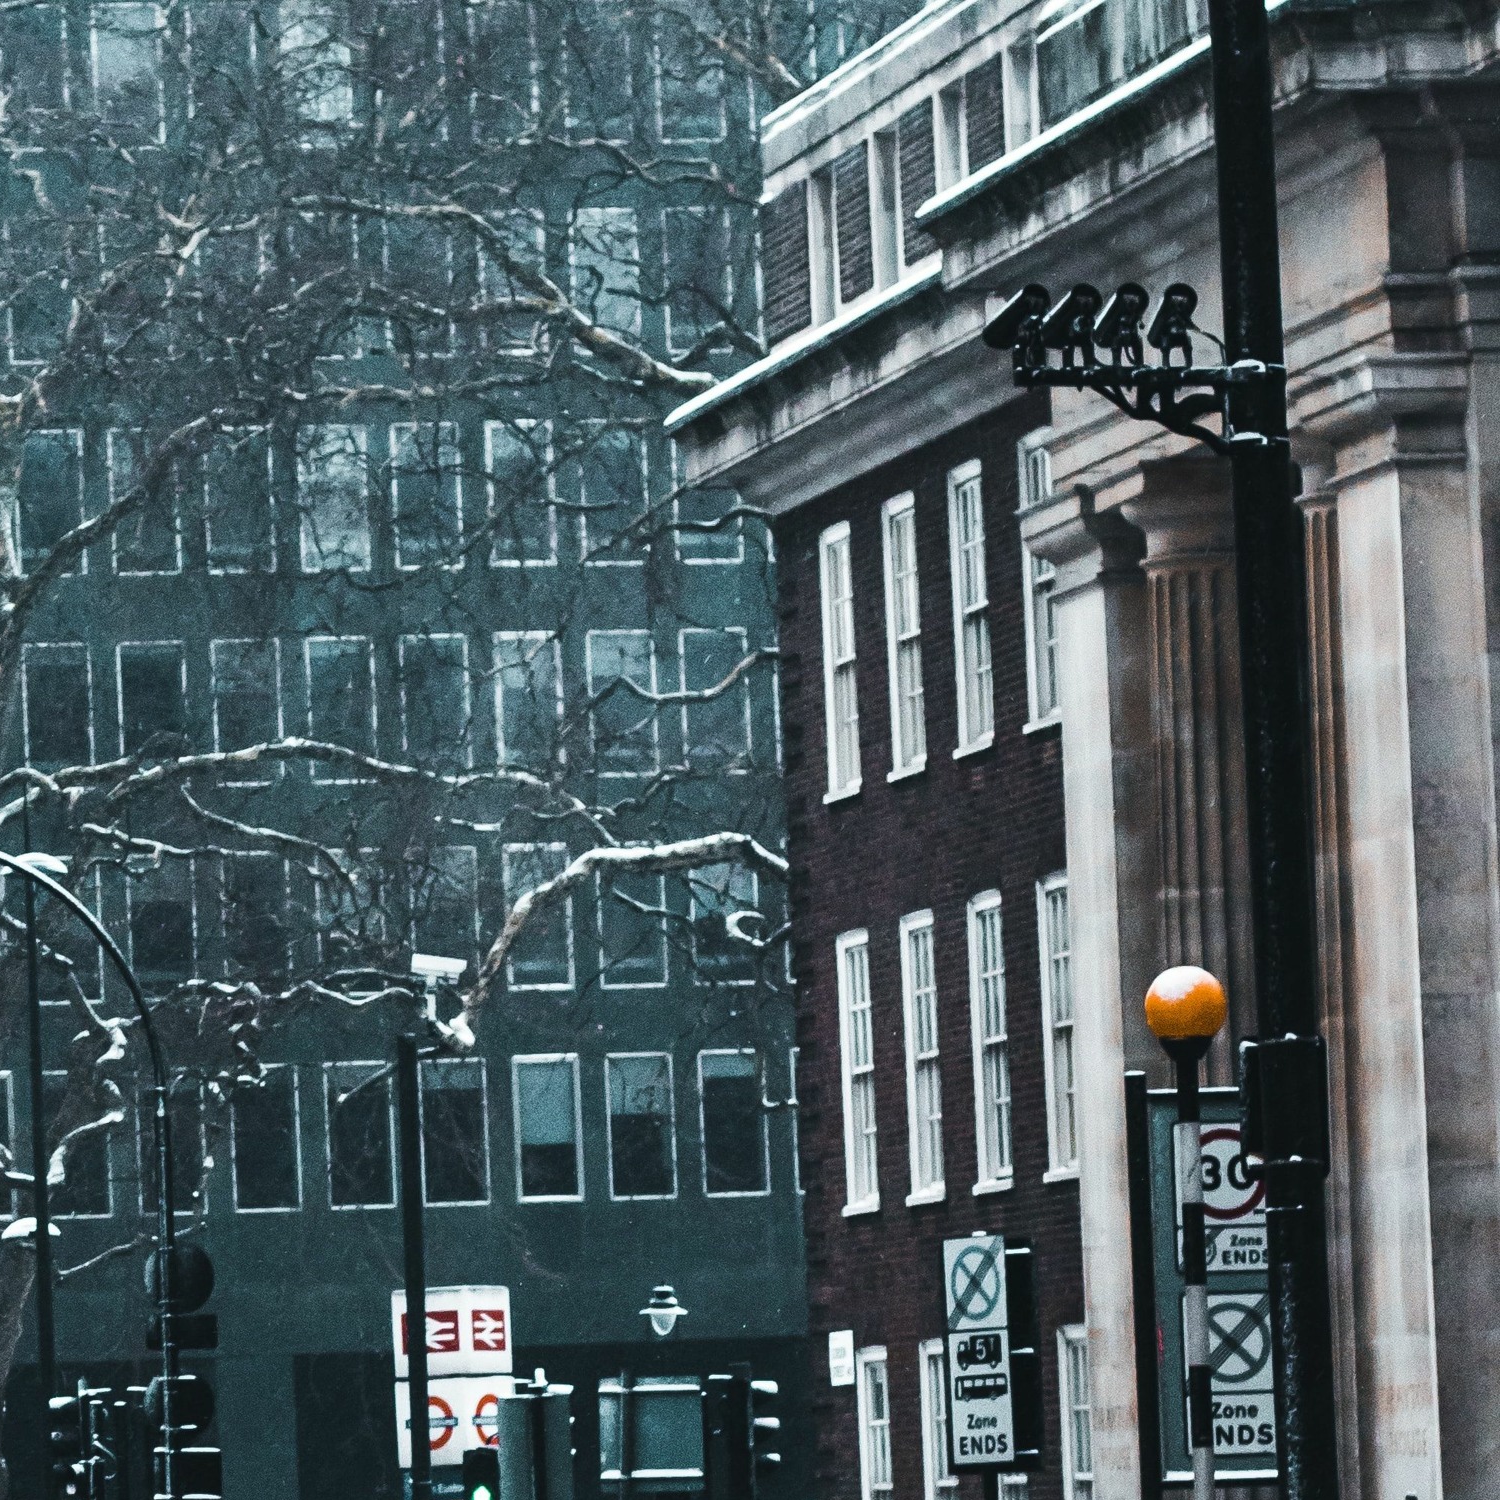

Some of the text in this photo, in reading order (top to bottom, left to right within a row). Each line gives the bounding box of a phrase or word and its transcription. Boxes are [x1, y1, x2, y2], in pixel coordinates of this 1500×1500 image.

[1201, 1154, 1256, 1192] 30
[1230, 1234, 1263, 1247] Zone
[1212, 1402, 1259, 1419] Zone
[967, 1413, 998, 1430] Zone
[959, 1433, 1008, 1456] ENDS
[1215, 1423, 1274, 1446] NDS
